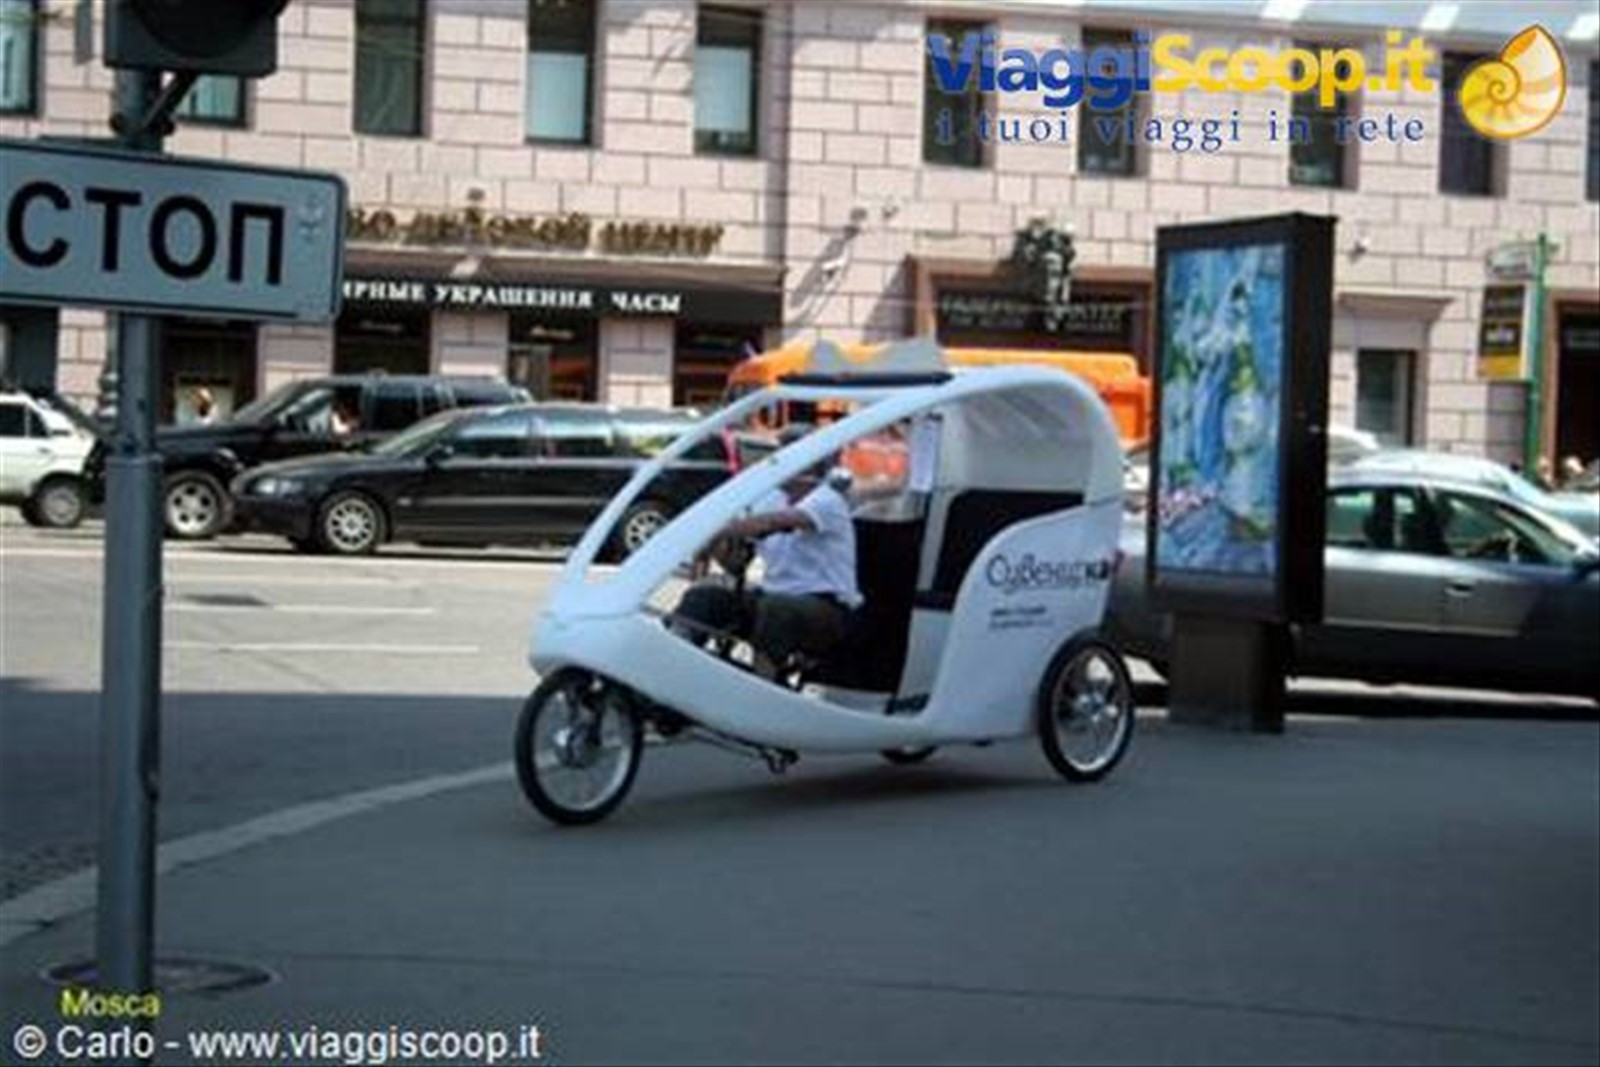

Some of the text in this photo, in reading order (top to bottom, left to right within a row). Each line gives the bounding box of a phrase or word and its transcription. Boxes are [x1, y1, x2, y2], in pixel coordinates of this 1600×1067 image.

[6, 180, 285, 286] СТОП
[434, 284, 592, 309] УКРАШЕНИЯ
[611, 291, 681, 313] ЧАСЫ
